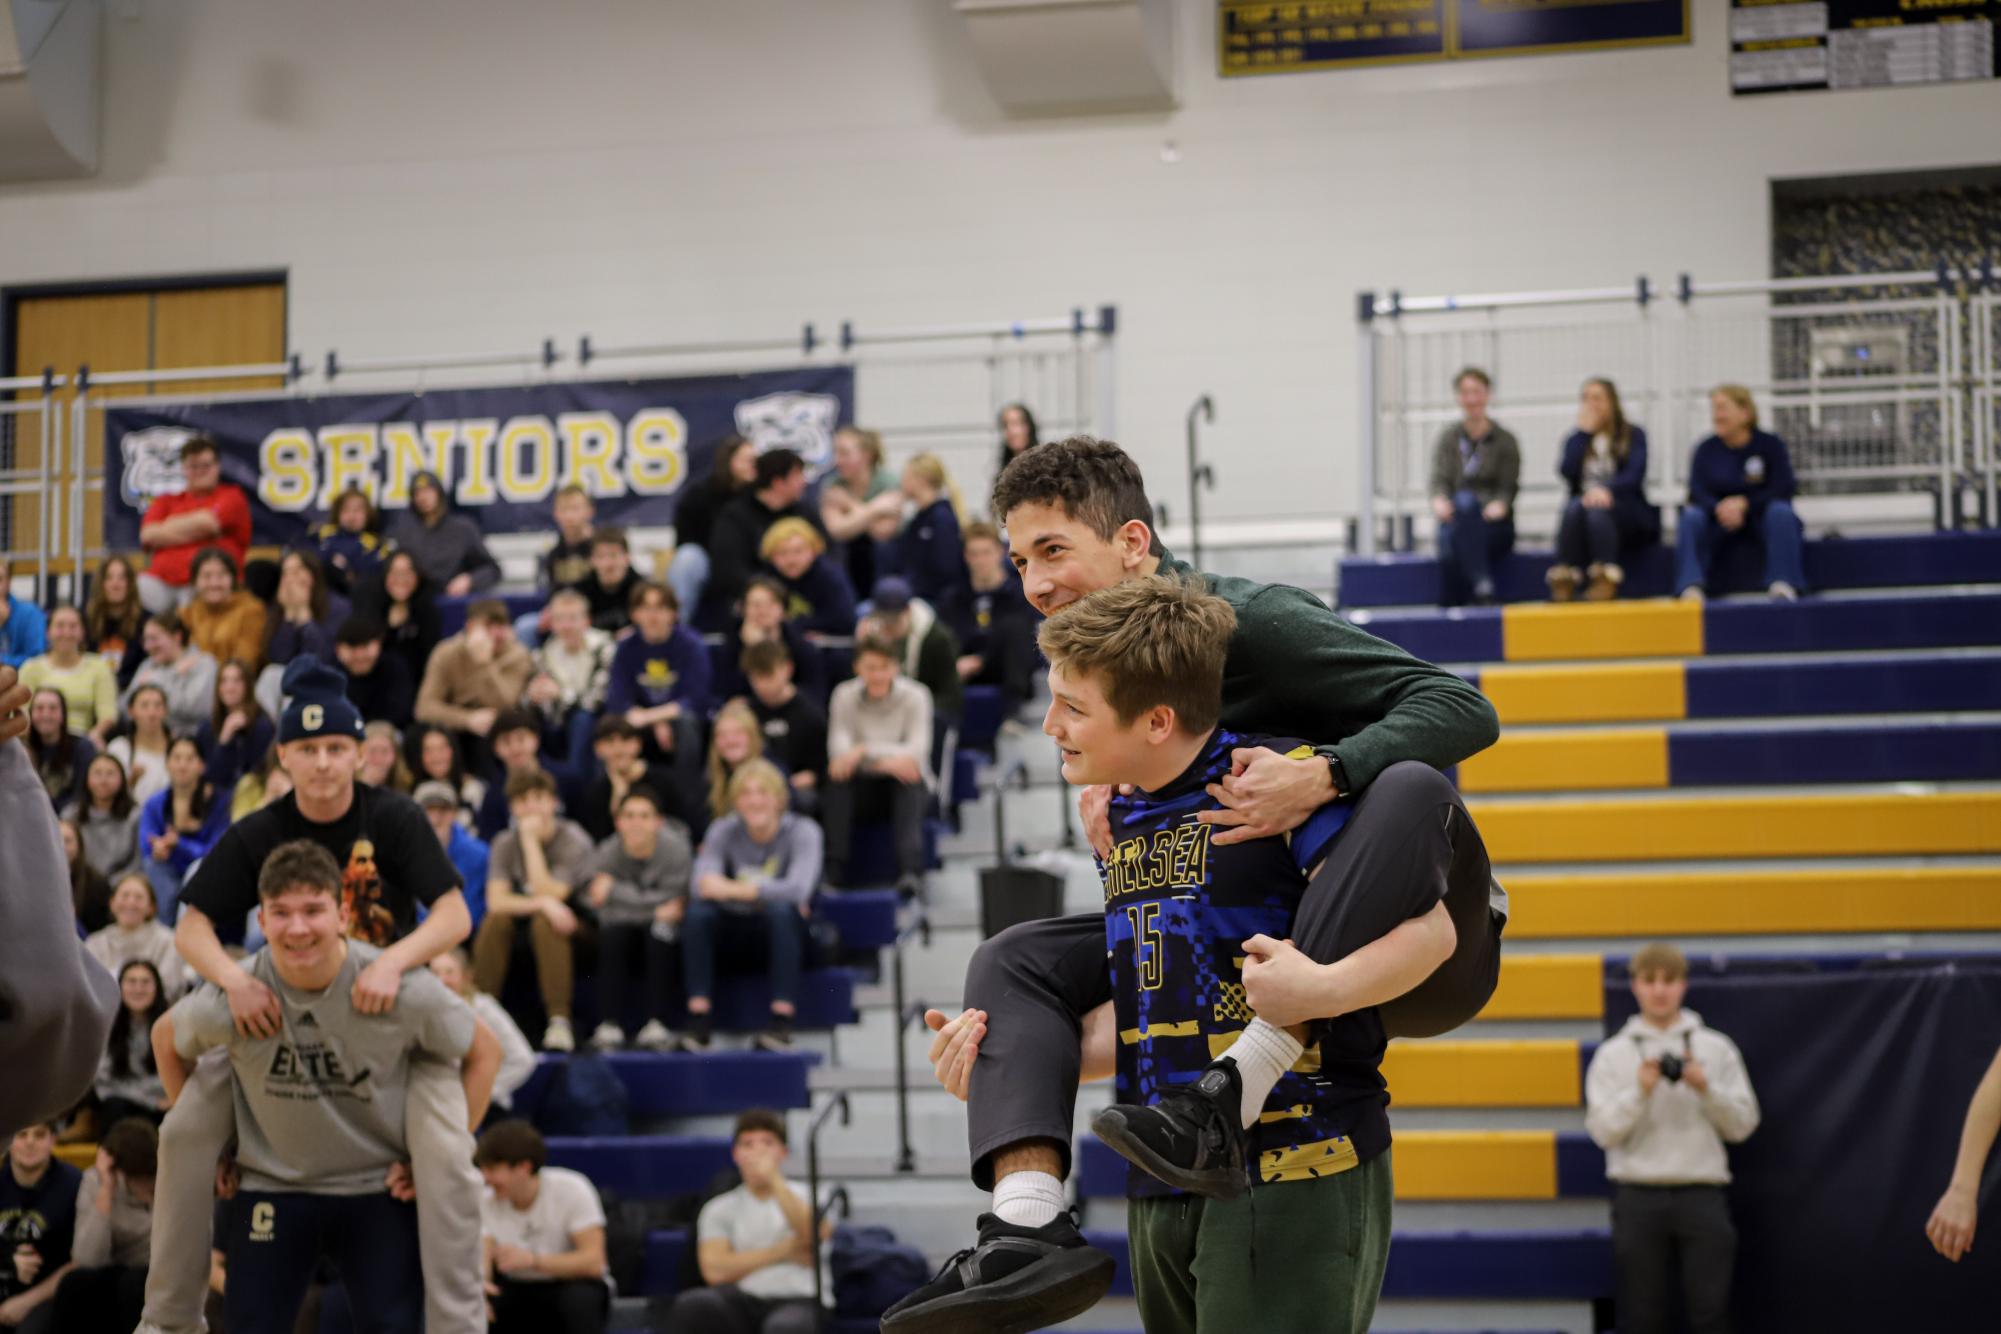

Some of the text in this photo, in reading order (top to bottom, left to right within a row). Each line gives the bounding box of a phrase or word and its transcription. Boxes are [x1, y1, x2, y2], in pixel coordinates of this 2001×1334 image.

[258, 407, 687, 511] SENIORS
[302, 704, 324, 731] C
[1128, 902, 1162, 991] 15
[252, 1201, 274, 1232] C
